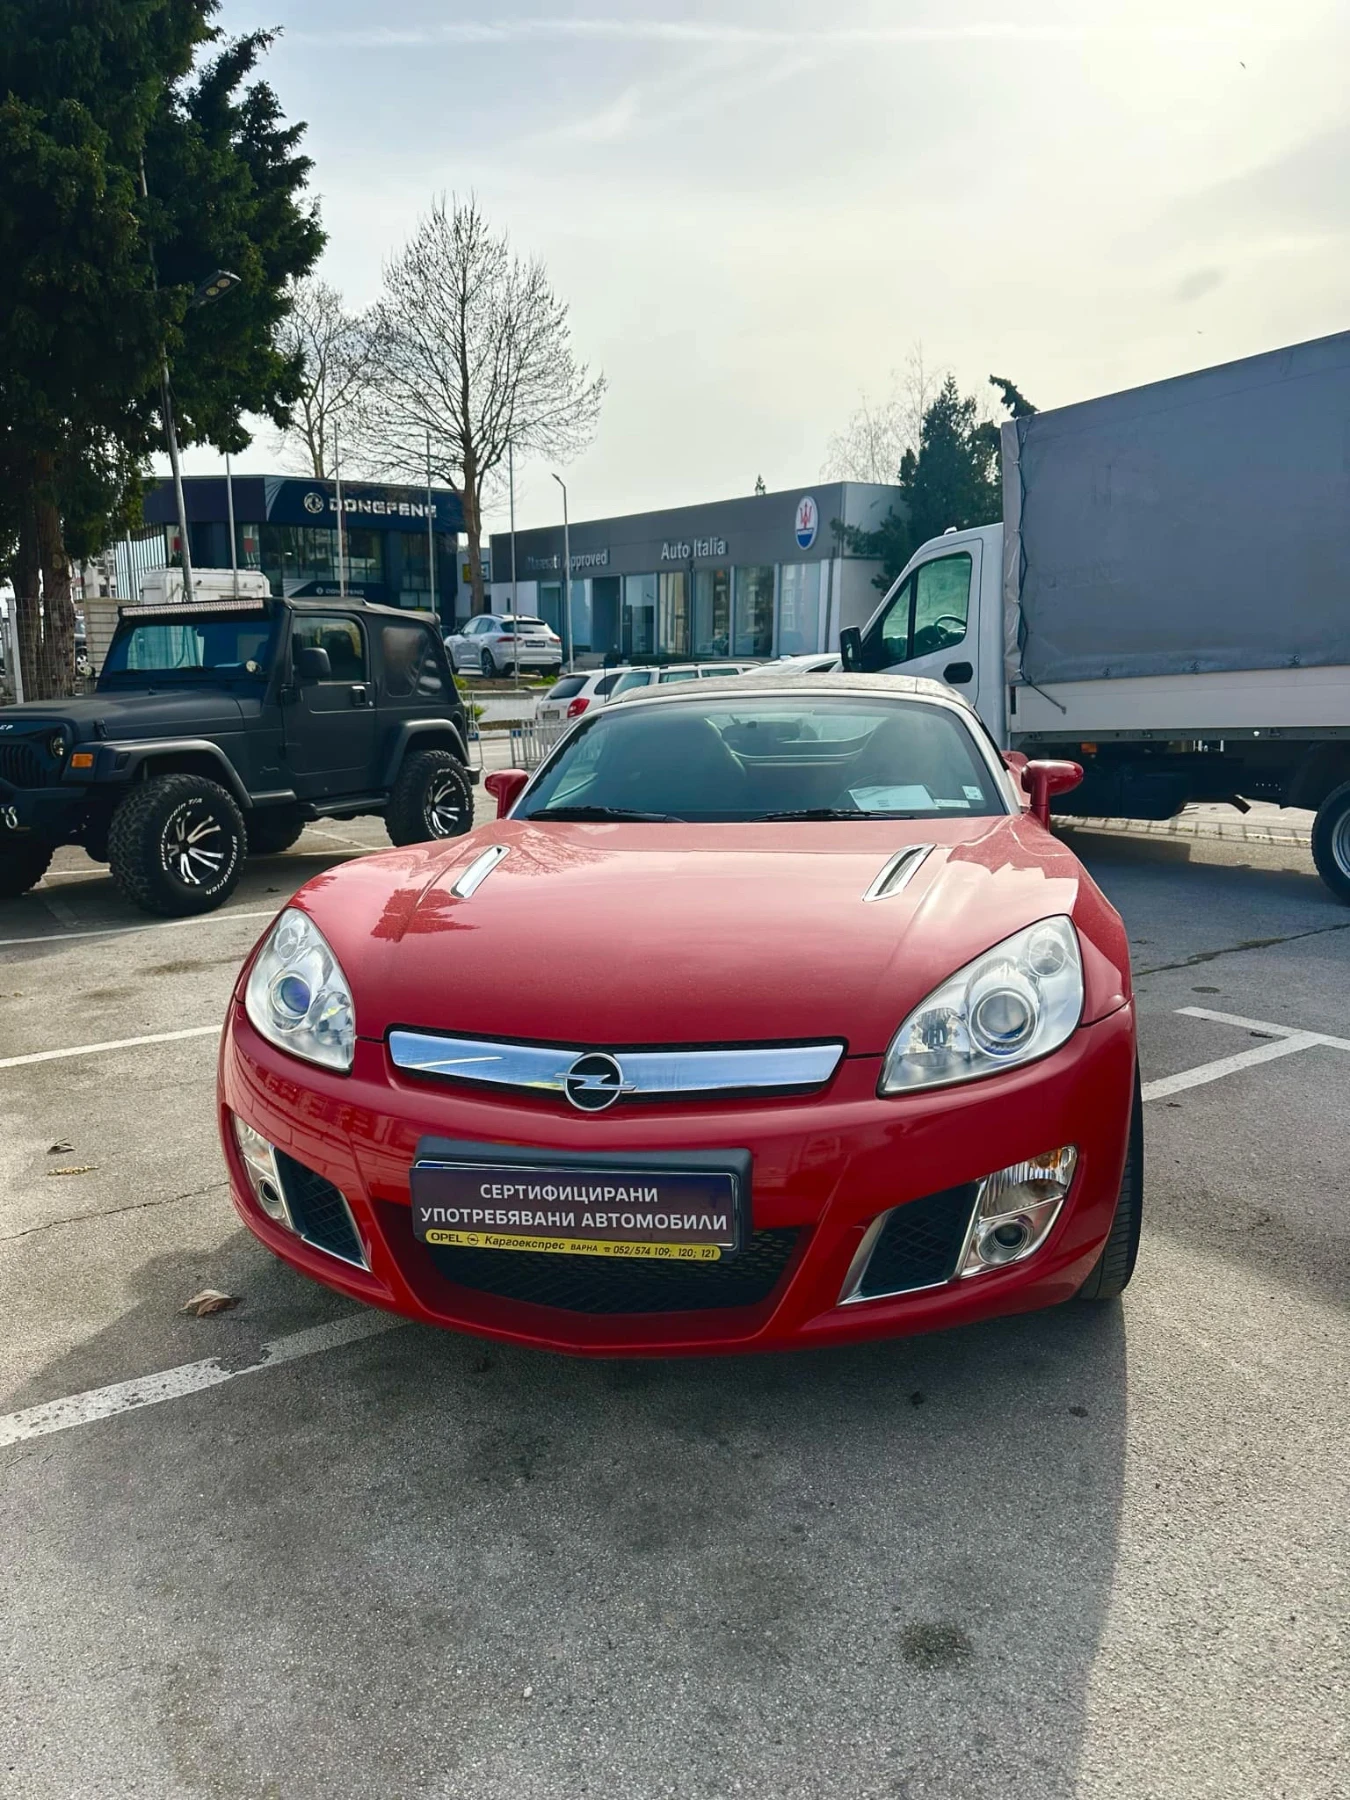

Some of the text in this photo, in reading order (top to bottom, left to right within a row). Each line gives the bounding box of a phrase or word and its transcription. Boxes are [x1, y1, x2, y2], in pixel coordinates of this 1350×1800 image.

[329, 498, 437, 518] DONGFENG
[661, 537, 726, 560] Auto Italia
[205, 835, 239, 896] BFGoodrich
[480, 1184, 658, 1205] СЕРТИФИЦИРАНИ
[420, 1207, 727, 1230] УПОТРЕБЯВАНИ АВТОМОБИЛИ
[430, 1232, 463, 1243] OPEL
[485, 1236, 565, 1250] Каргоекспрес
[571, 1244, 598, 1252] ВАРНА
[613, 1245, 651, 1255] 052/574
[701, 1249, 715, 1258] 121
